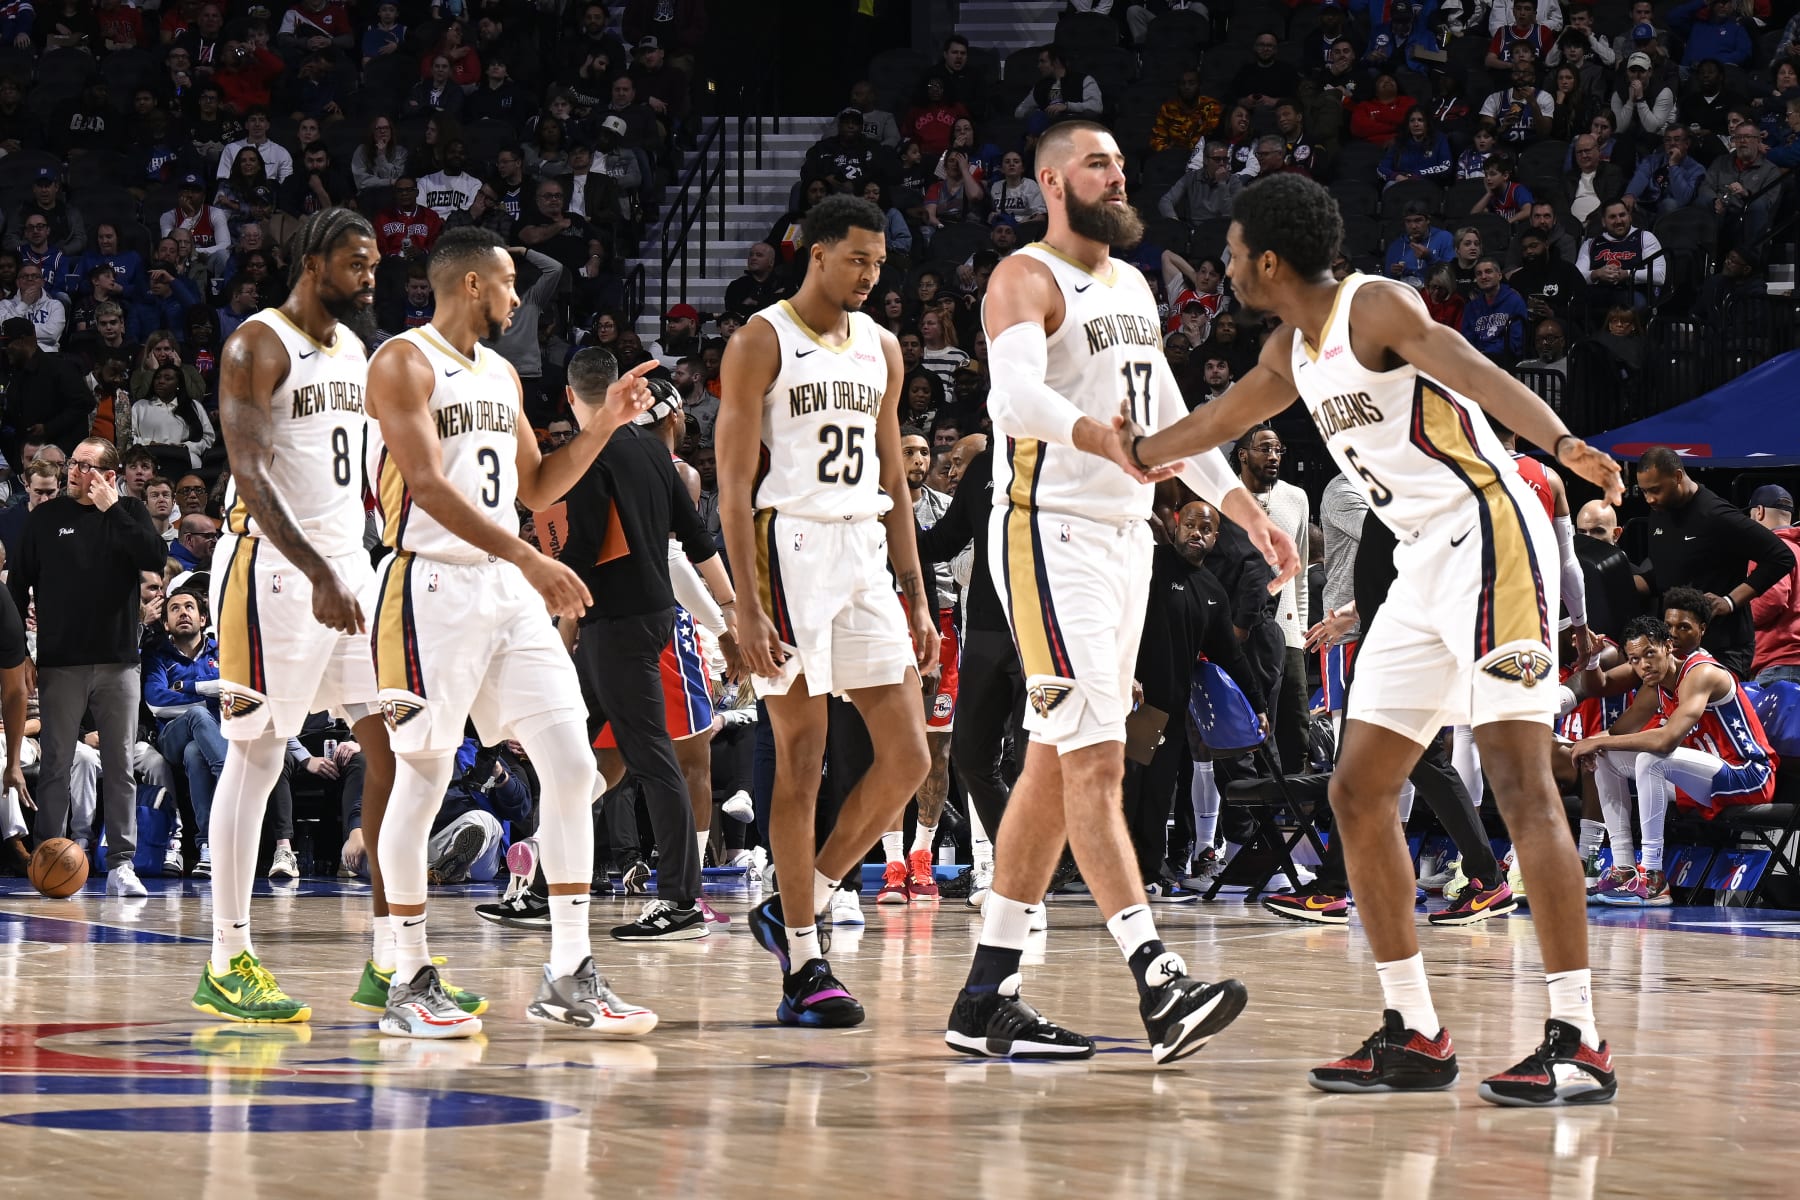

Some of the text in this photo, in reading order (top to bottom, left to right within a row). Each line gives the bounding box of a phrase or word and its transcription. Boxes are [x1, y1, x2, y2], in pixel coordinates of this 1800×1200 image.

[1084, 315, 1119, 355] NEW
[293, 383, 325, 419] NEW
[436, 402, 474, 440] NEW
[787, 382, 825, 418] NEW
[1121, 362, 1151, 426] 17
[331, 426, 351, 487] 8
[476, 447, 501, 508] 3
[818, 424, 865, 486] 25
[1344, 445, 1393, 507] 5
